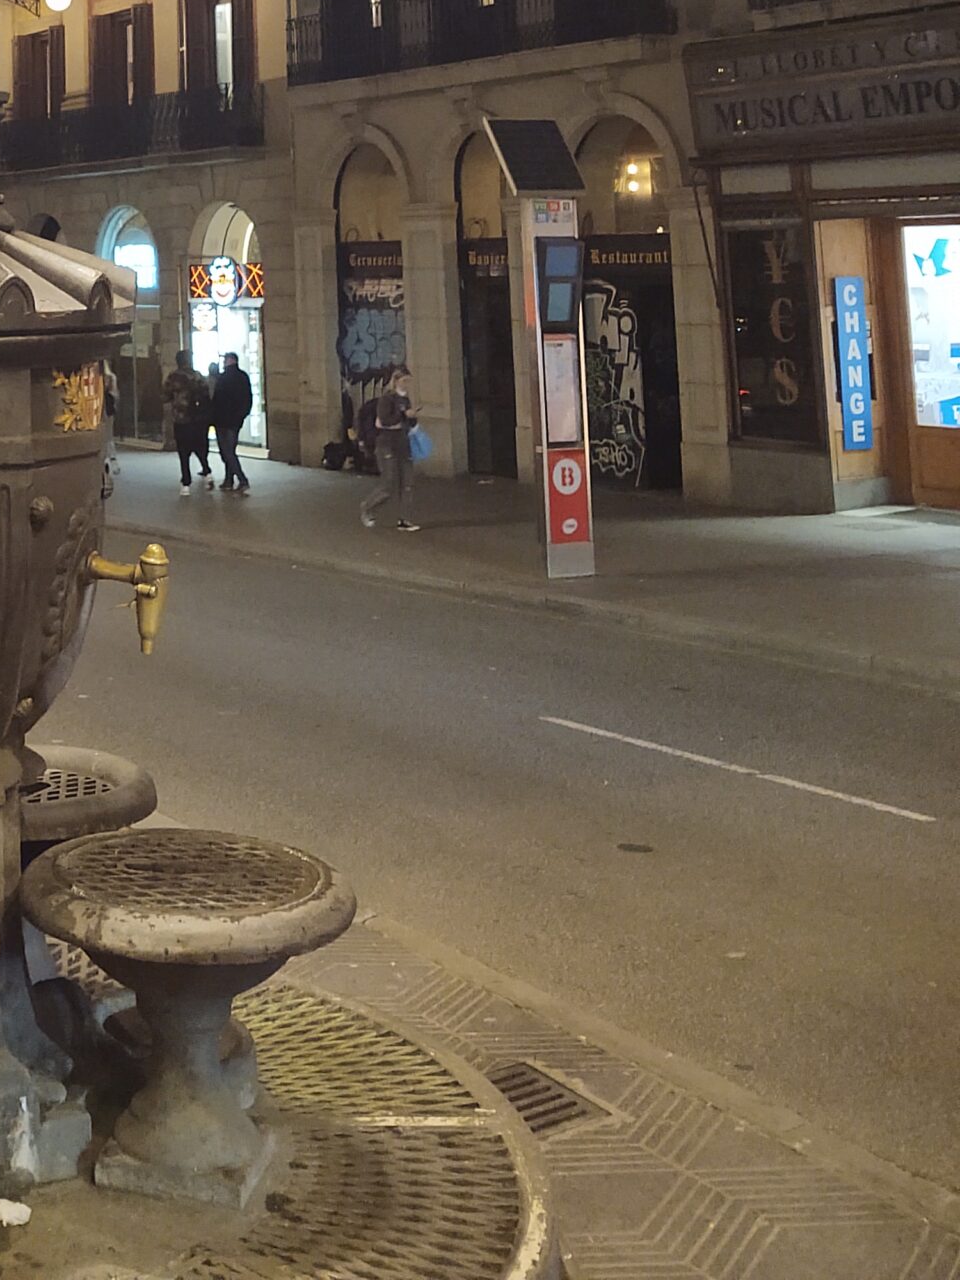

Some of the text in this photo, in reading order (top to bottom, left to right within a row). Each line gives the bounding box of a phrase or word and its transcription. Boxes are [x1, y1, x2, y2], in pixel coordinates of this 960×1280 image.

[714, 90, 853, 135] MUSICAL
[590, 249, 669, 265] Restaurant
[843, 284, 866, 443] CHANGE
[560, 466, 575, 487] B
